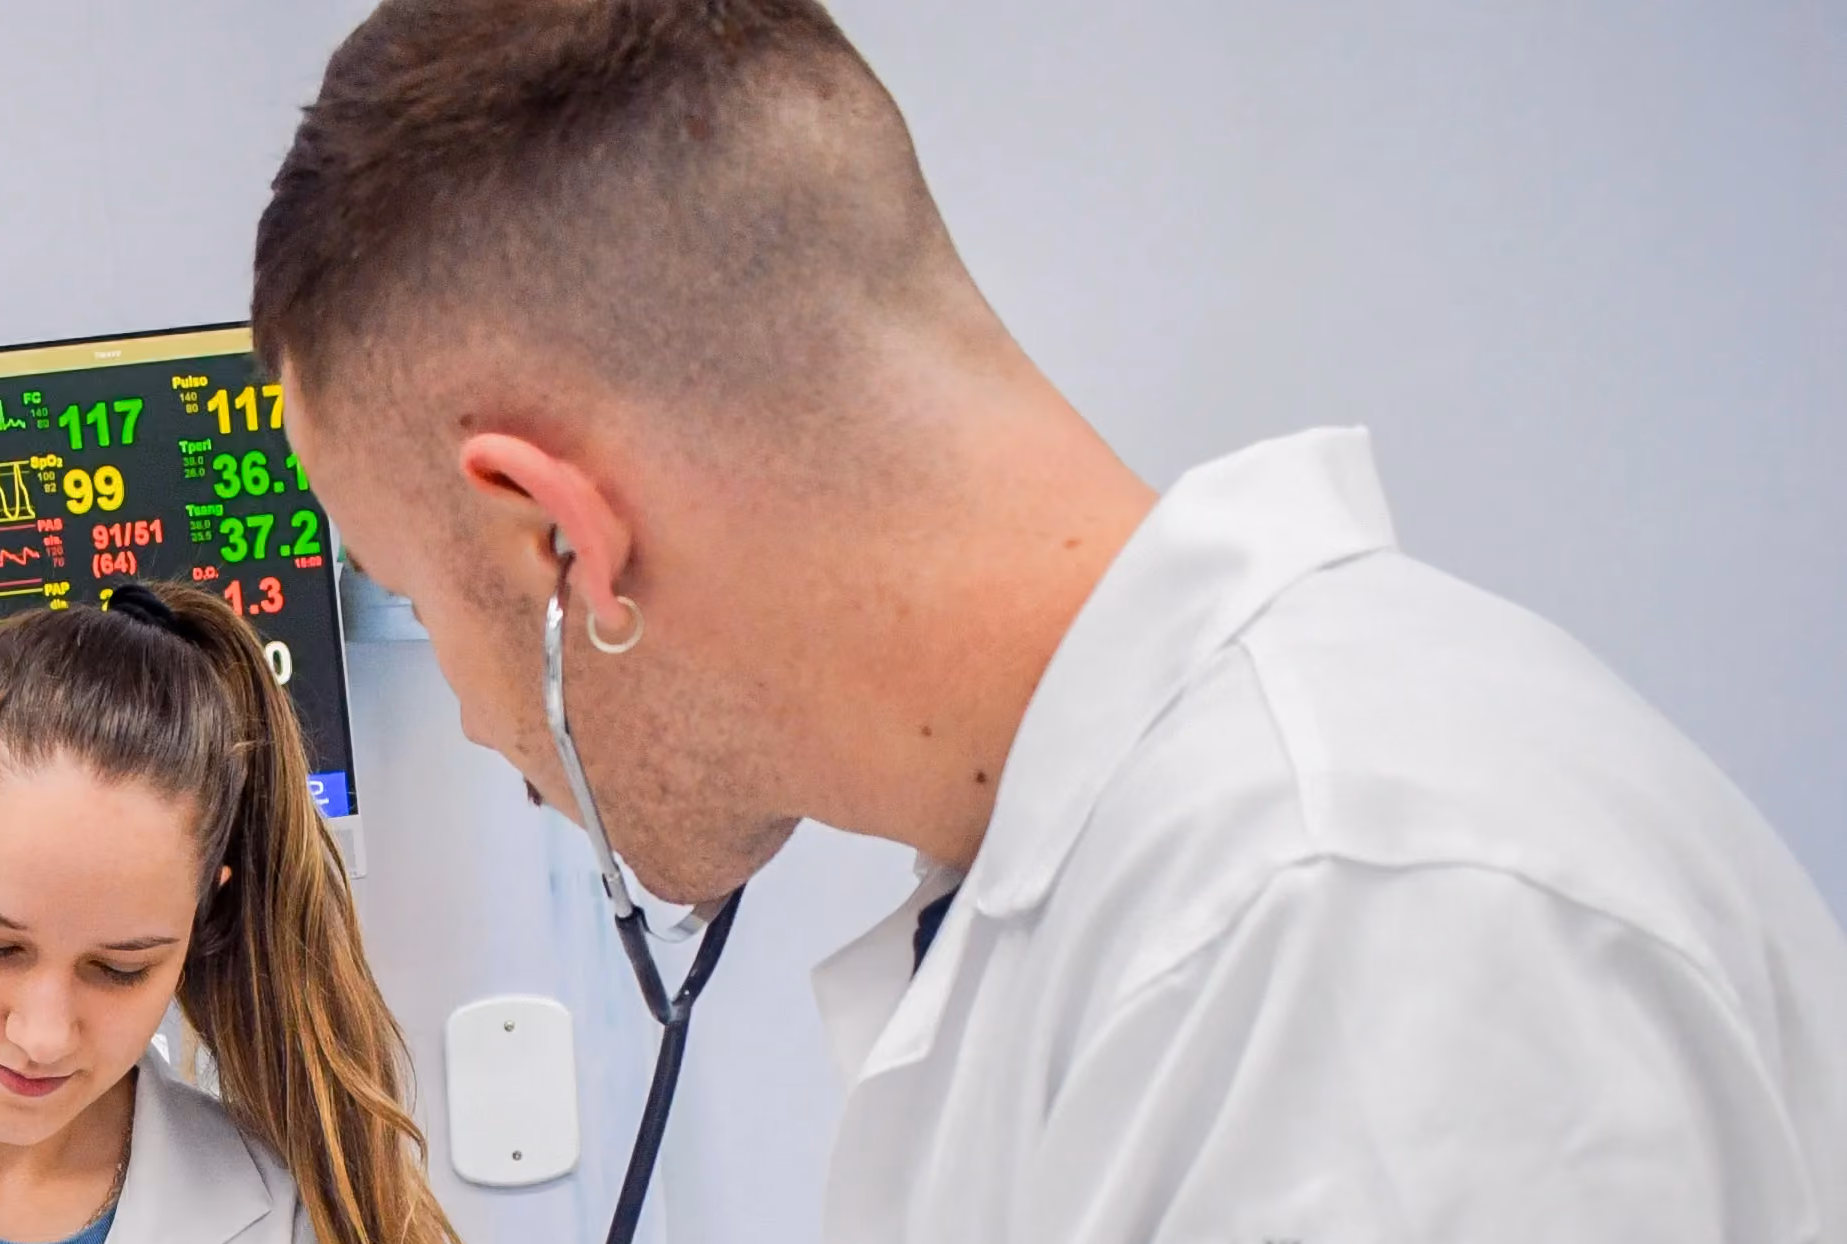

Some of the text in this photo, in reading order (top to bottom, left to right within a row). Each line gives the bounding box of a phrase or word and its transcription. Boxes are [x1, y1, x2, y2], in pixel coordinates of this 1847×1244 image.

[58, 398, 143, 450] 117
[207, 384, 284, 434] 117
[63, 465, 124, 514] 99
[212, 451, 309, 499] 36.1
[92, 519, 163, 550] 91/51
[219, 510, 321, 562] 37.2
[92, 551, 137, 579] (64)
[224, 576, 285, 616] 1.3
[265, 641, 293, 685] 0
